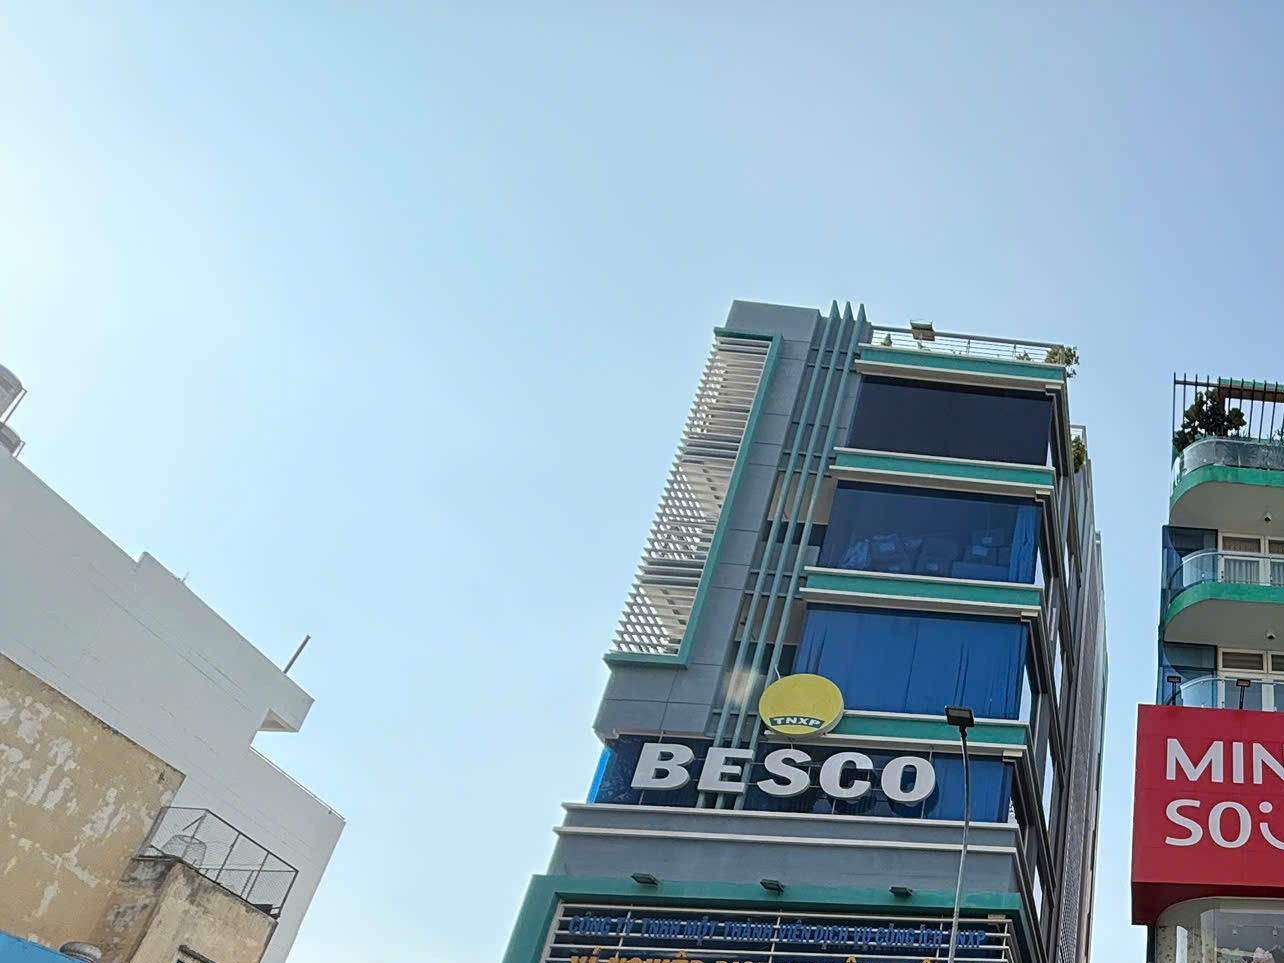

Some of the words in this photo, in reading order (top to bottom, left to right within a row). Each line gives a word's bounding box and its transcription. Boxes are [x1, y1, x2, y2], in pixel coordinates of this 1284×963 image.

[773, 716, 822, 728] TNXP
[631, 742, 936, 803] BESCO
[616, 917, 634, 937] TY
[641, 918, 680, 938] TNHH
[948, 929, 987, 949] NXP
